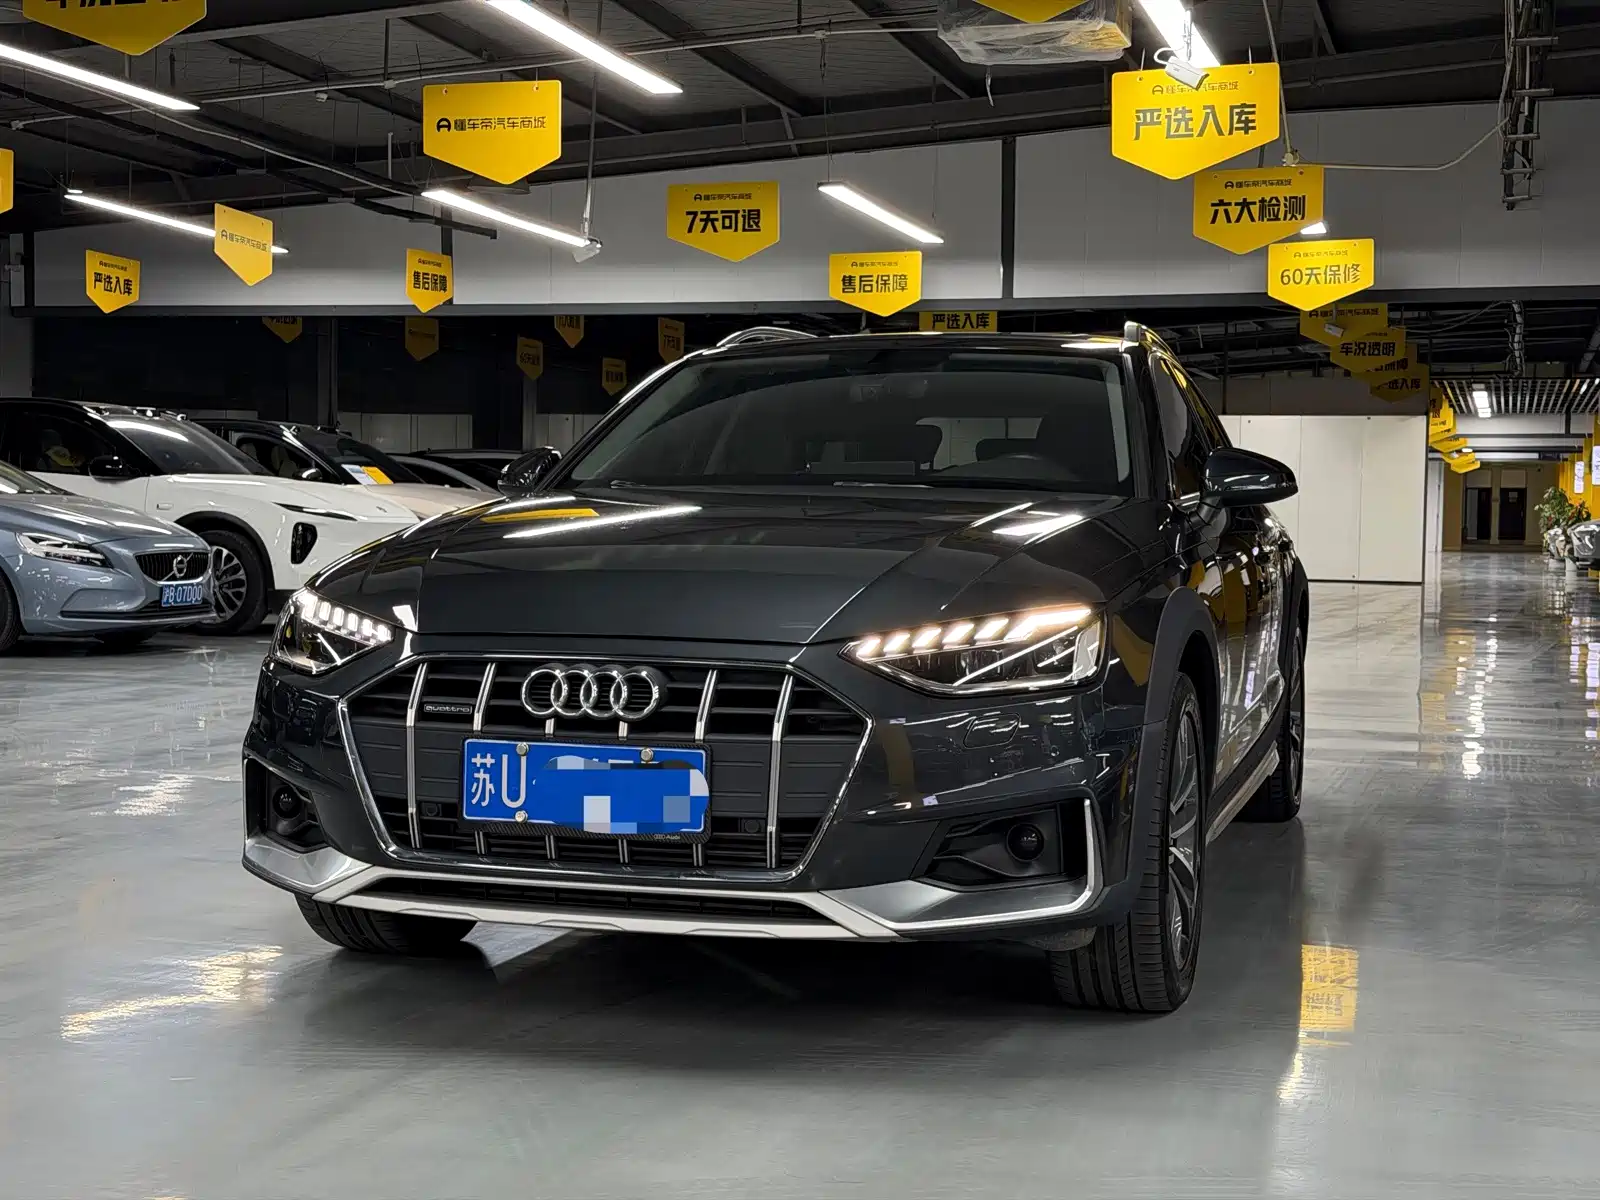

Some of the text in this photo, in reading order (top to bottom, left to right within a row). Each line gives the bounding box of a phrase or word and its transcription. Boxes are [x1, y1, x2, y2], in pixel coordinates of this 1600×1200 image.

[1166, 81, 1239, 94] 懂车车商城
[454, 116, 546, 131] 懂车帝汽车商城
[1134, 103, 1256, 140] 严选入库
[1210, 195, 1306, 224] 六大检测
[685, 209, 761, 233] 7天可退
[94, 272, 132, 296] 严选入库
[413, 270, 447, 293] 售后保障
[841, 274, 908, 293] 售后保障
[1280, 263, 1361, 285] 60天保修
[932, 312, 989, 330] 严选入库
[1340, 341, 1396, 356] 车况透明
[425, 705, 470, 713] quattro
